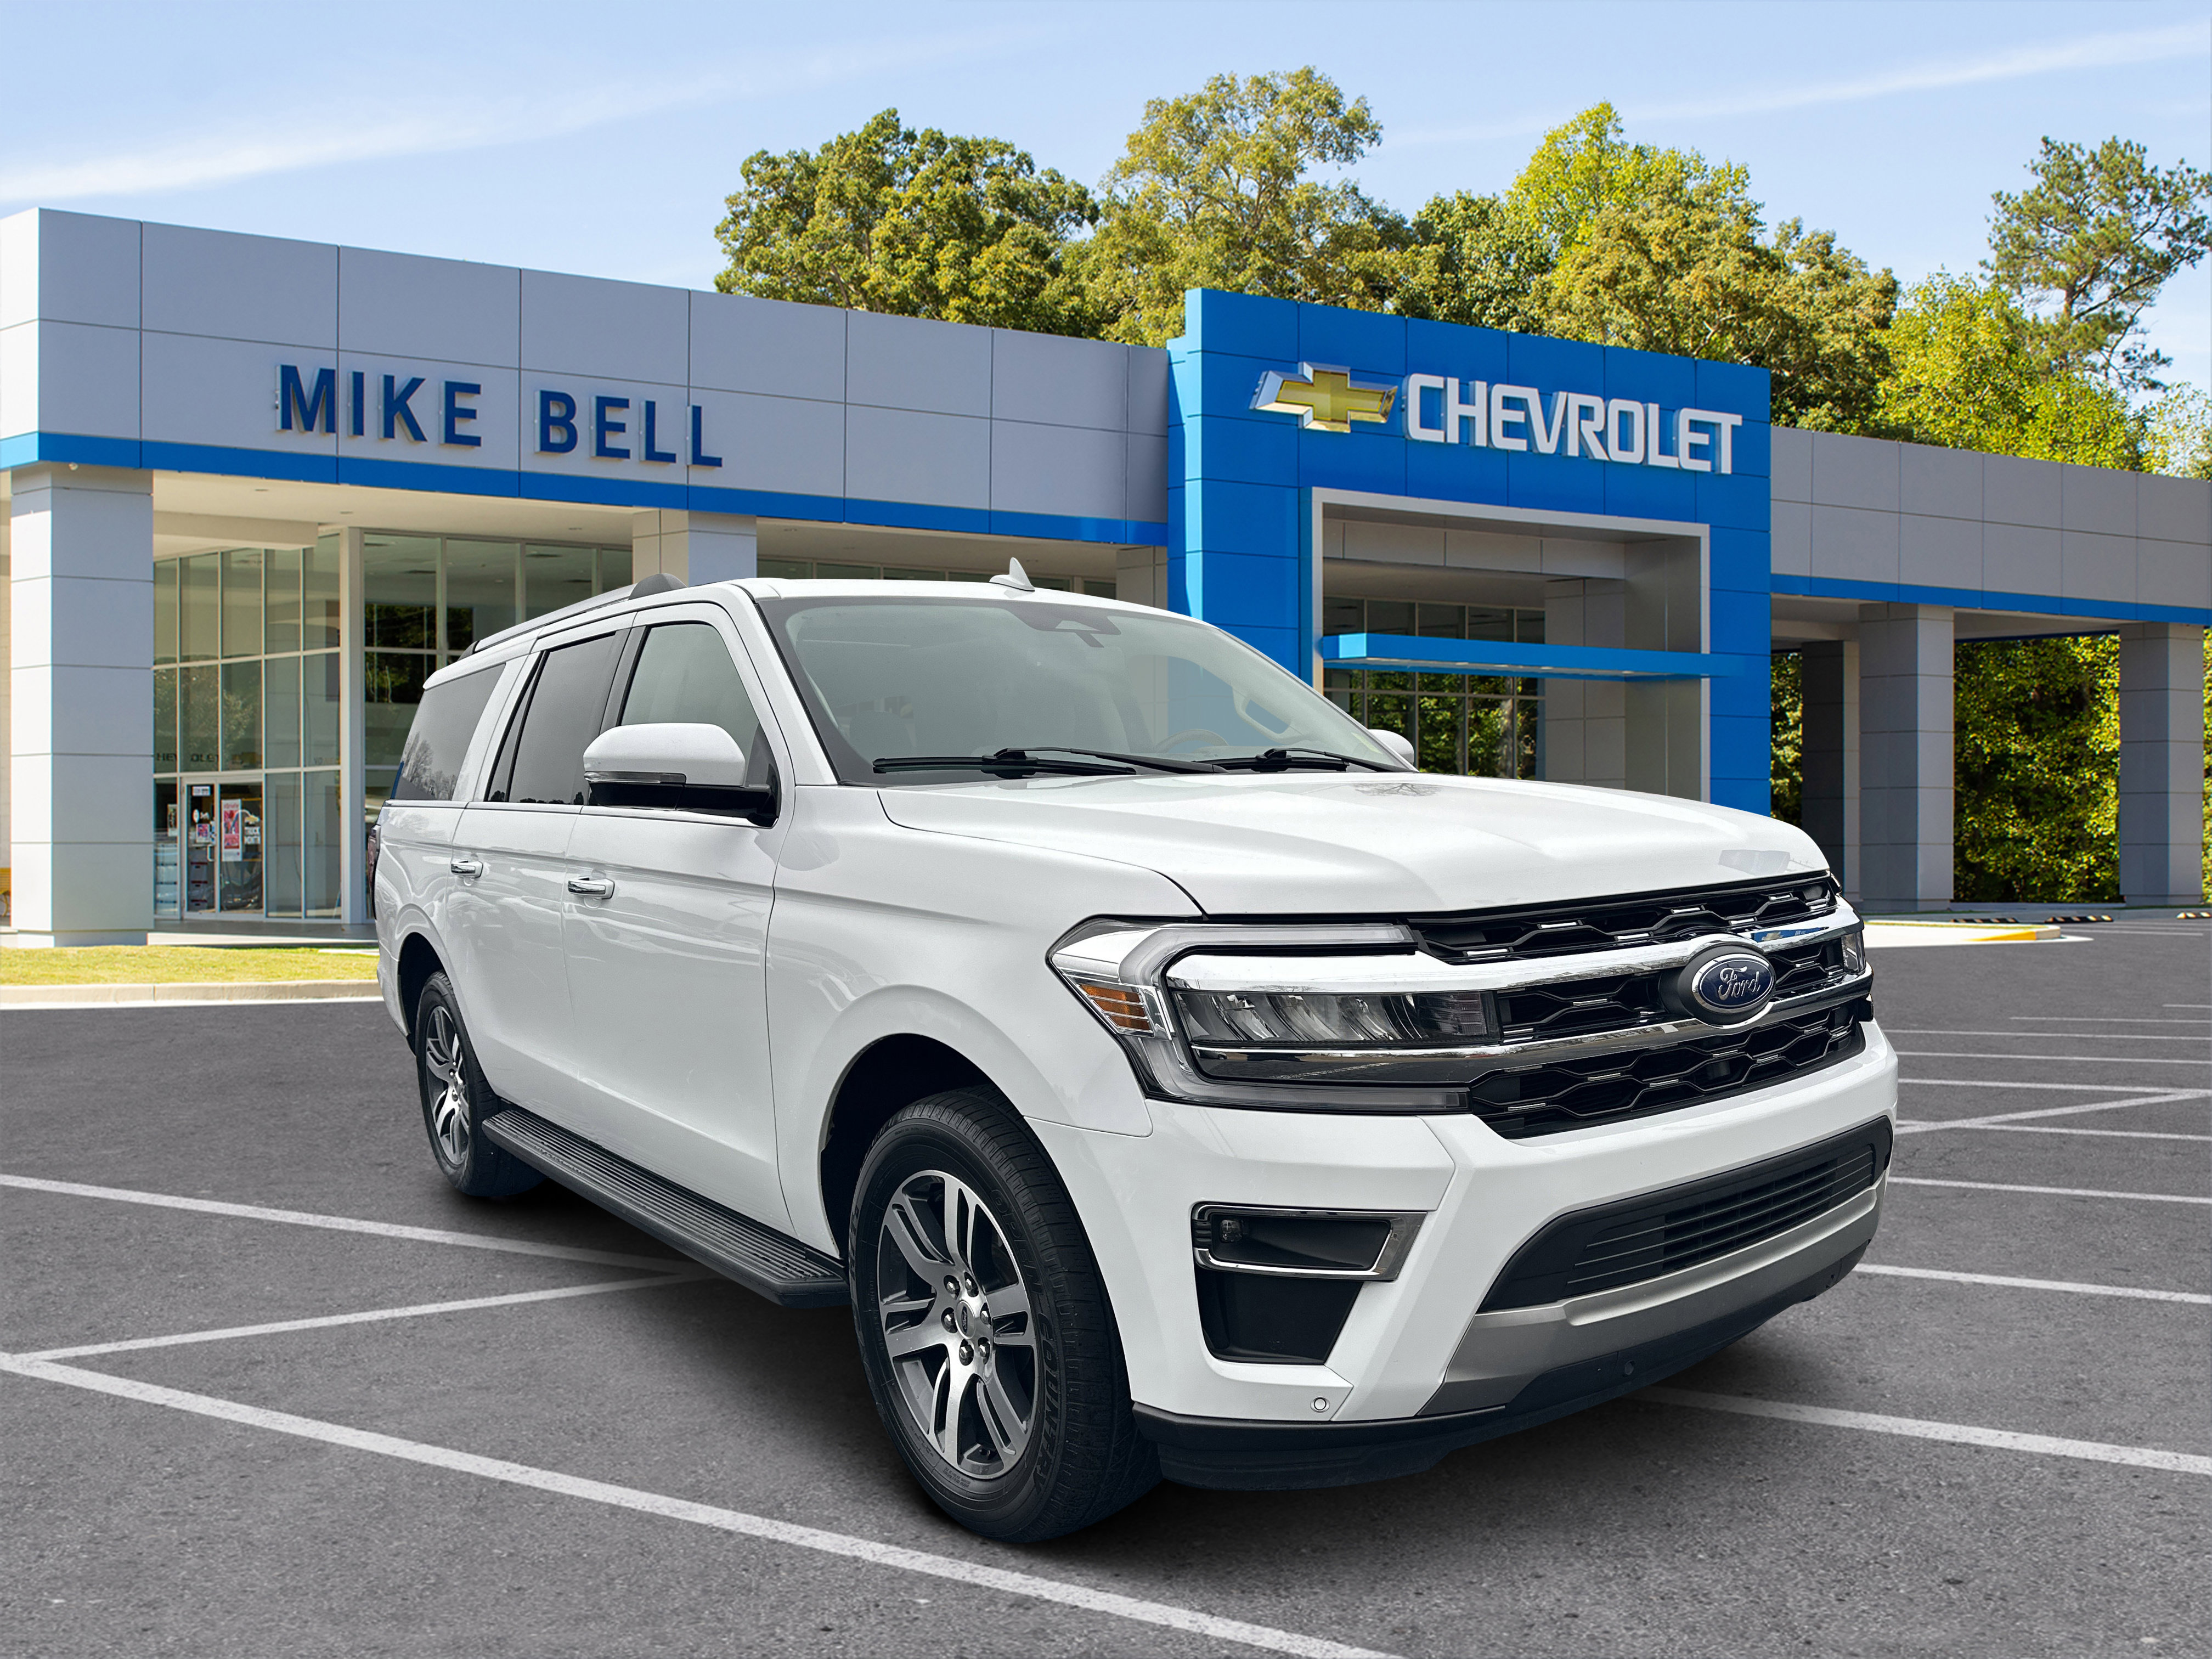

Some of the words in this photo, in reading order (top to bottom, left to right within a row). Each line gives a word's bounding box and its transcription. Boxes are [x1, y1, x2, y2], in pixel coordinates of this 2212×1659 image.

[276, 364, 482, 447] MIKE
[535, 390, 723, 467] BELL
[1403, 373, 1742, 475] CHEVROLET
[1718, 966, 1760, 1001] Ford
